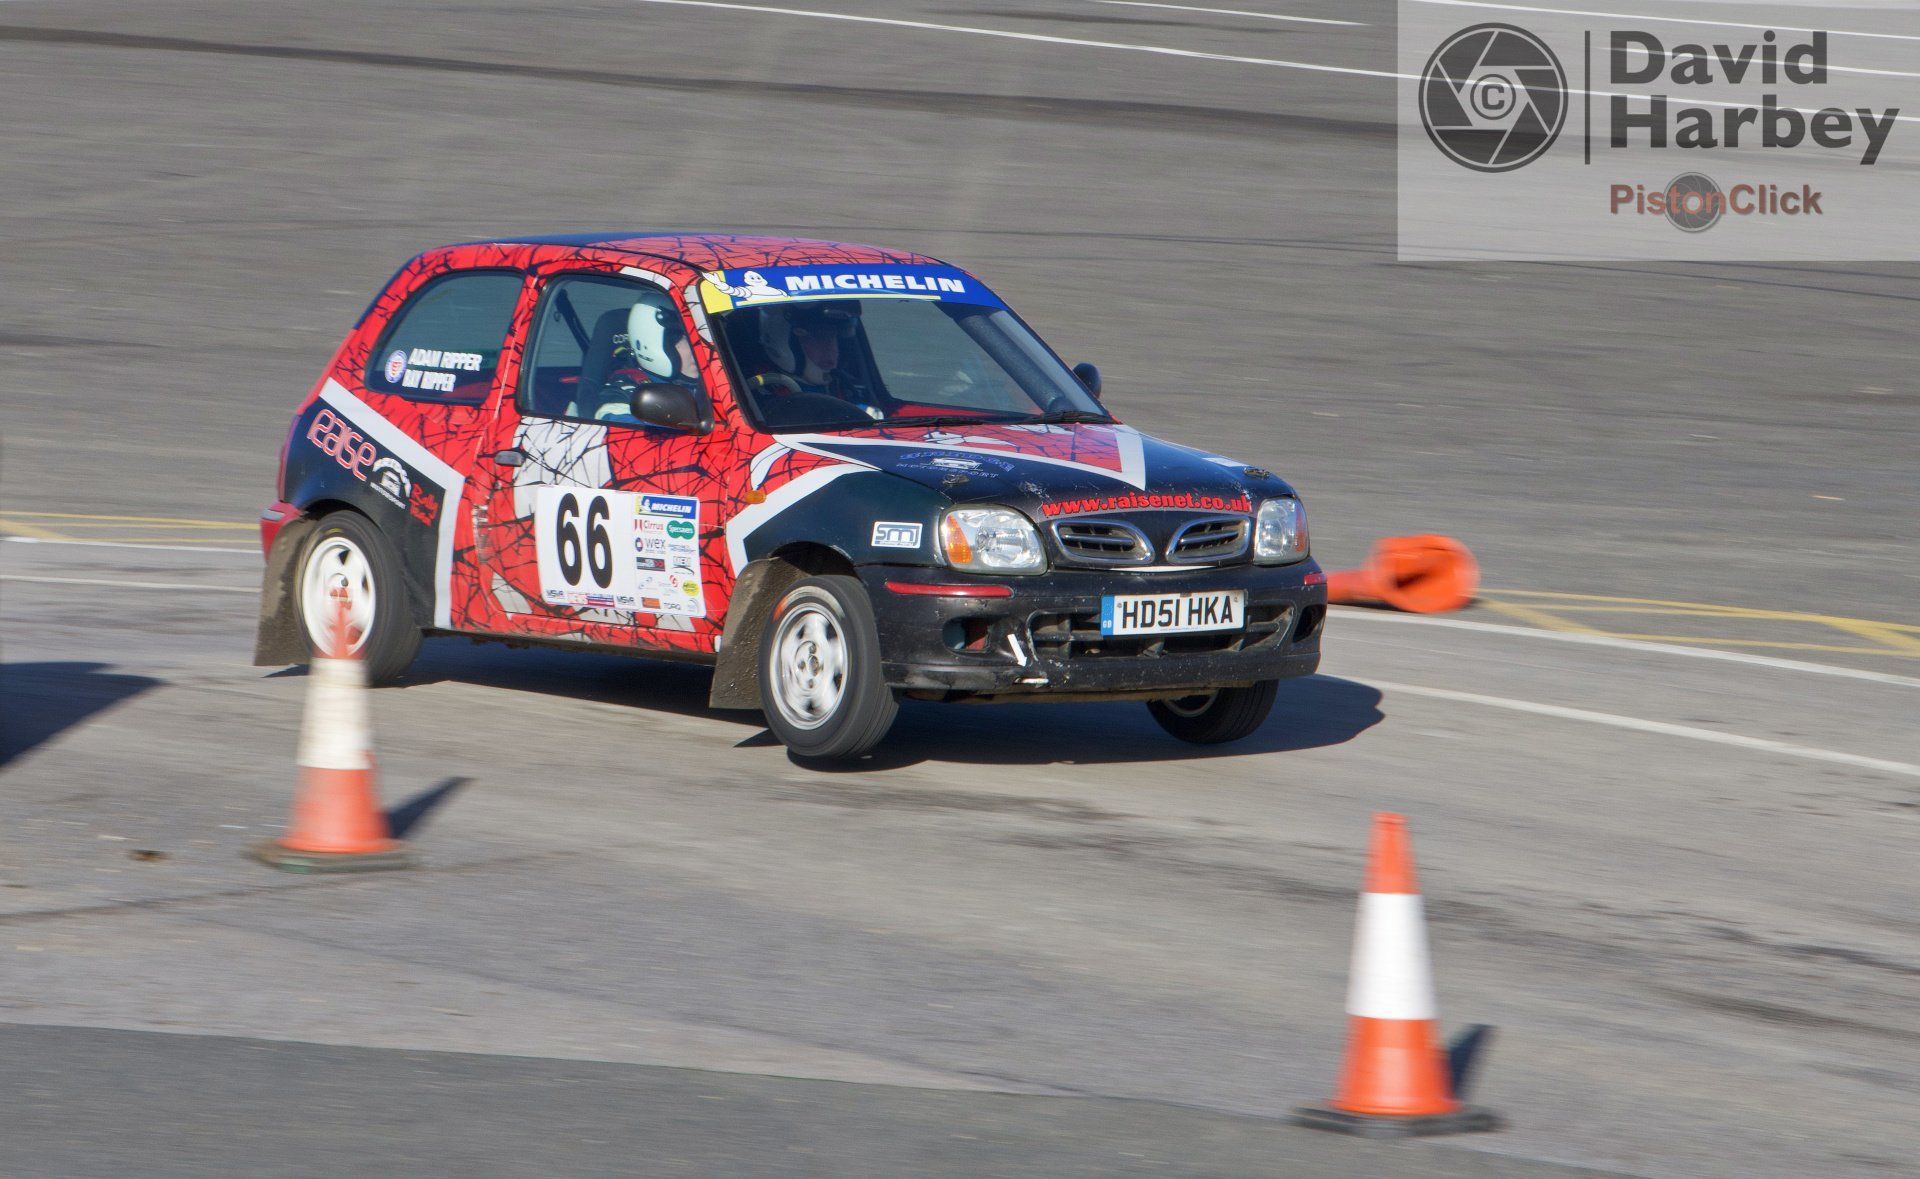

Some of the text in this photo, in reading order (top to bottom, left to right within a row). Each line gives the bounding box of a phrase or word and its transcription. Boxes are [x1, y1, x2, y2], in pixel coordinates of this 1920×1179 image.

[784, 274, 967, 294] MICHELIN
[651, 503, 693, 513] MICHELIN
[1042, 492, 1253, 517] www.raisenet.co.uk
[556, 492, 613, 589] 66
[1121, 595, 1233, 629] HD51 HKA
